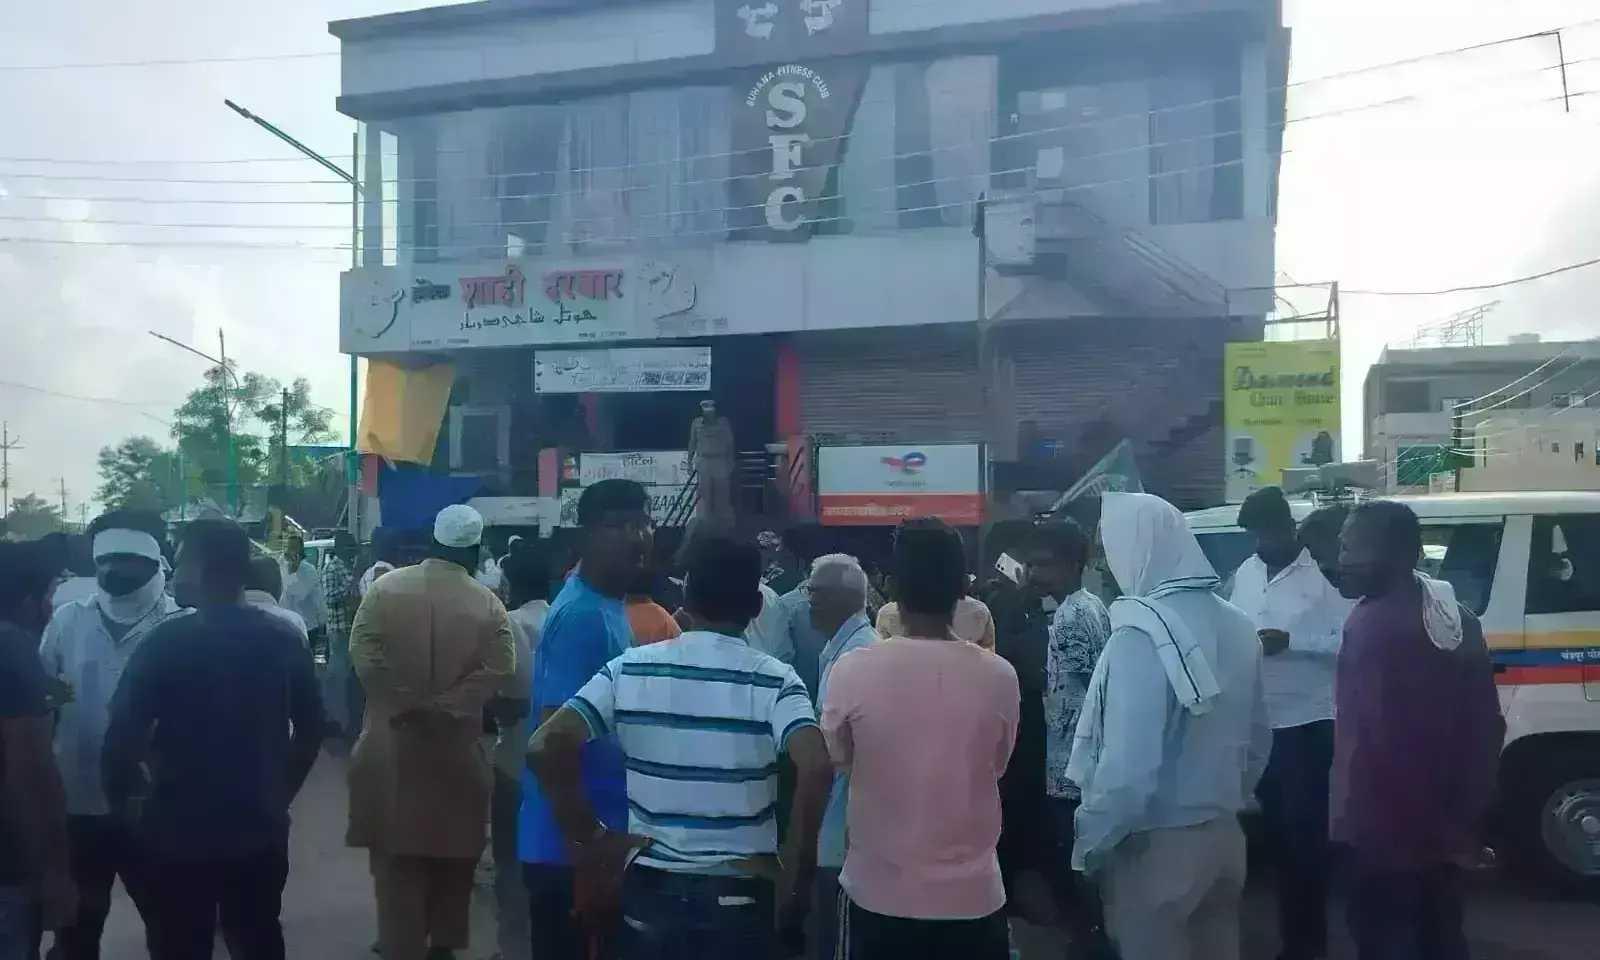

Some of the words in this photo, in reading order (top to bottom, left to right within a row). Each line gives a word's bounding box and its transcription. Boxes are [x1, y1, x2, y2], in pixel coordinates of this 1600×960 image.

[777, 64, 813, 80] FITNESS
[813, 75, 830, 100] CLUB
[765, 82, 810, 231] SFC
[459, 264, 526, 310] शाही
[541, 269, 624, 304] दरबार
